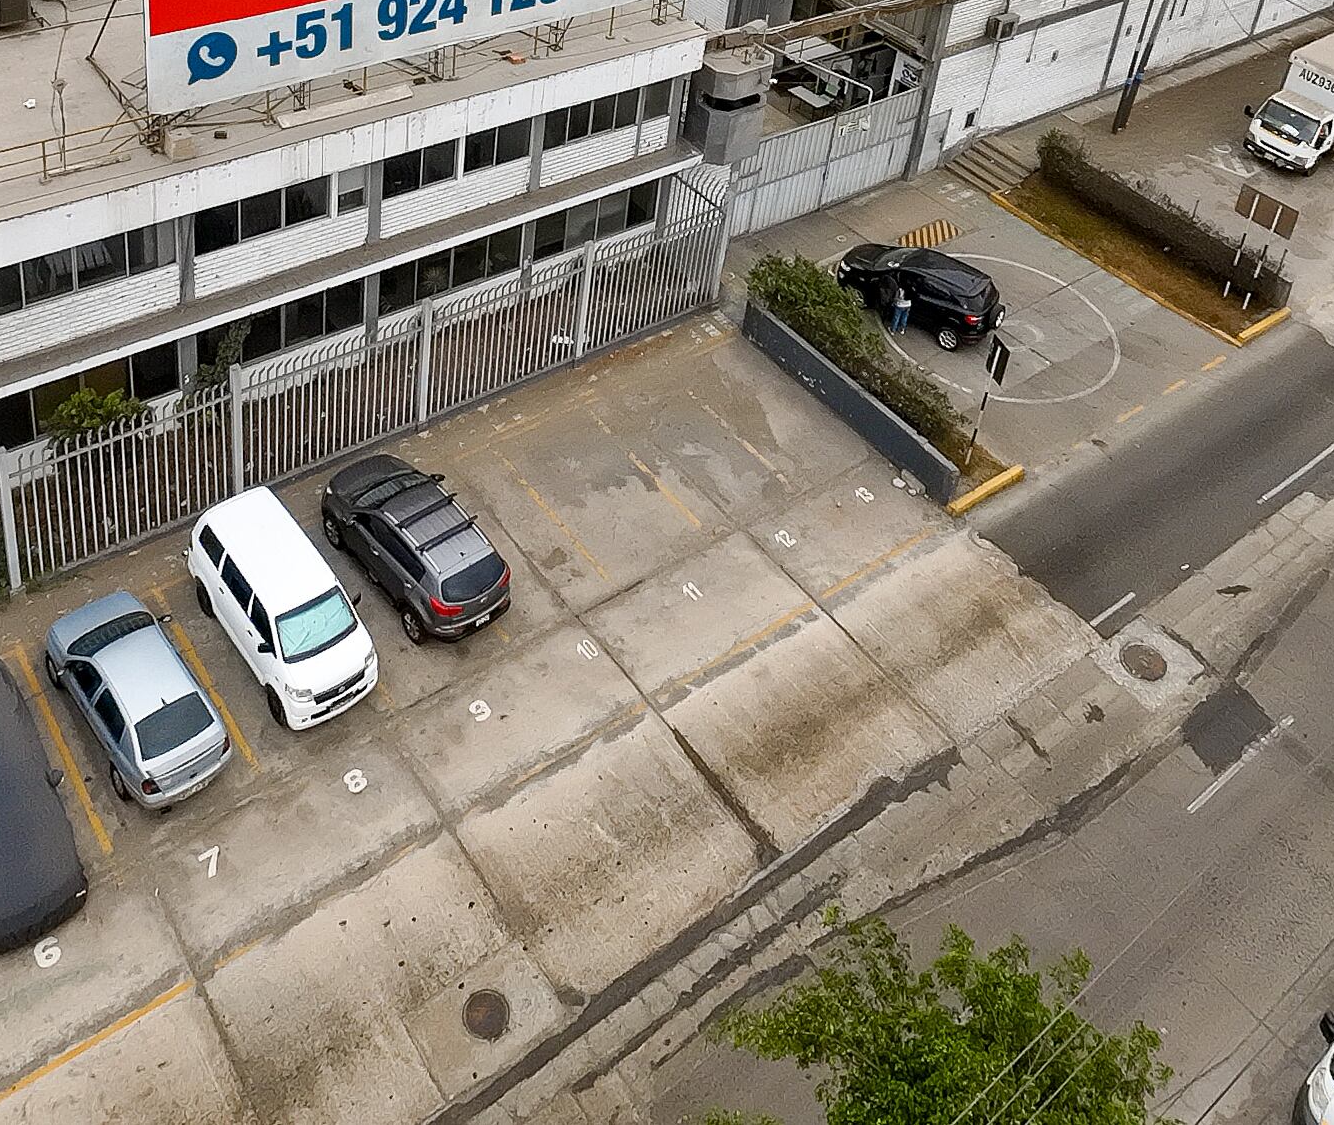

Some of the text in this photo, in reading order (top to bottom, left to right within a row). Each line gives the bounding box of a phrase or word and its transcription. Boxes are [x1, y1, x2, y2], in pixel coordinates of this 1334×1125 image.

[256, 2, 354, 67] +51
[854, 486, 875, 504] 13
[774, 529, 798, 548] 12
[682, 581, 704, 601] 11
[577, 639, 599, 660] 10
[468, 699, 492, 722] 9
[343, 768, 368, 794] 8
[197, 845, 220, 878] 7
[33, 936, 62, 968] 6
